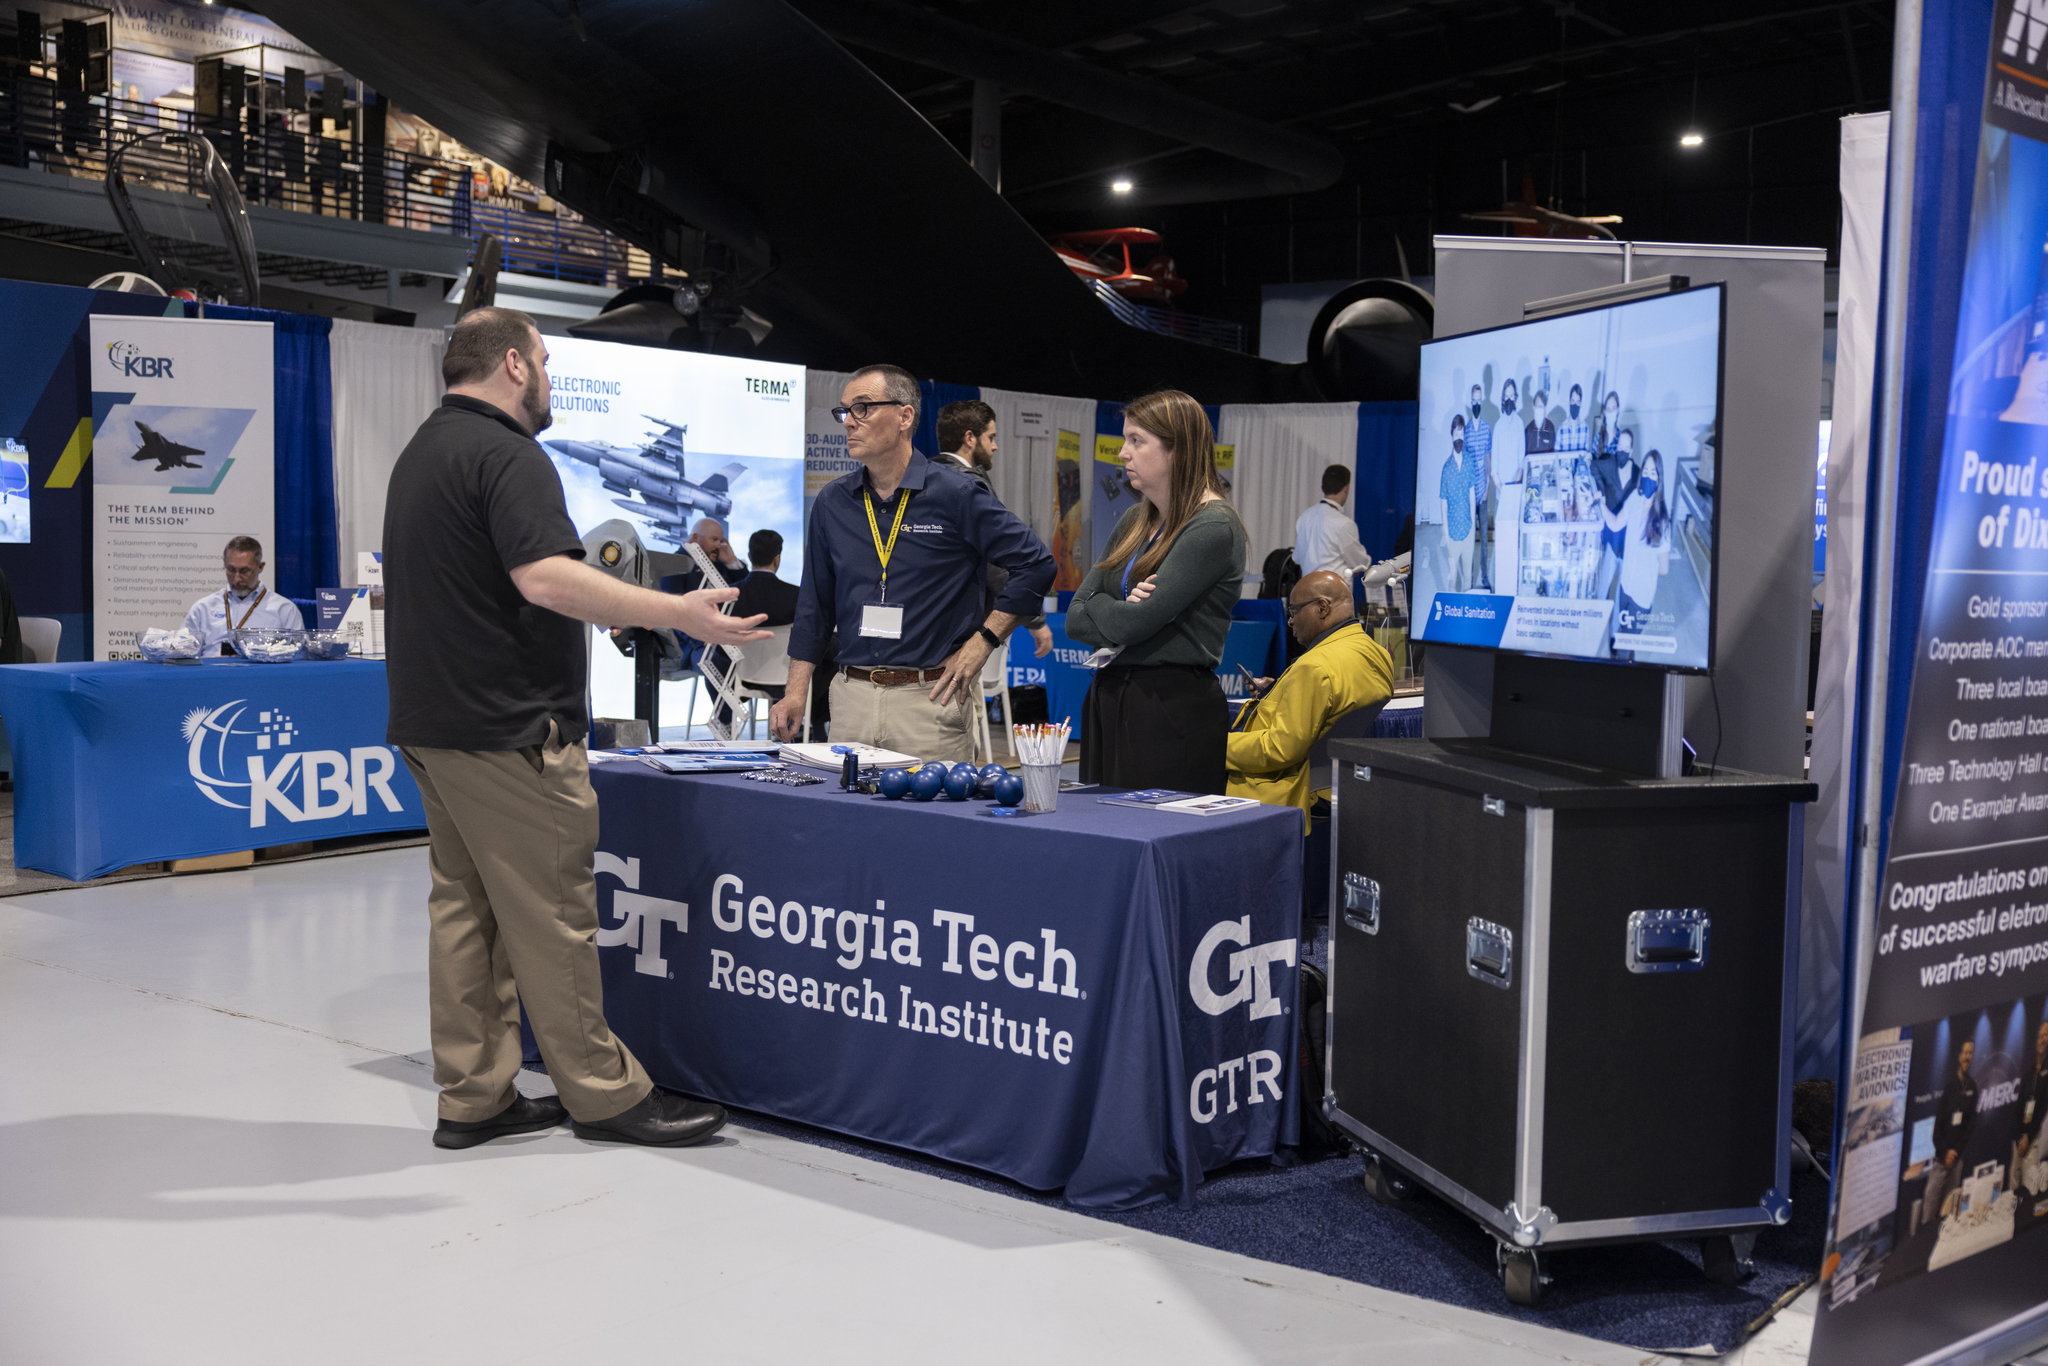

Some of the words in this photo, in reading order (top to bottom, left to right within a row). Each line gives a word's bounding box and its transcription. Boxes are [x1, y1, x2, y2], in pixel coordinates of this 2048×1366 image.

[201, 21, 255, 44] GENERAL
[125, 356, 174, 378] KBR
[551, 375, 621, 396] ELECTRONIC
[745, 377, 790, 397] TERMA
[806, 447, 842, 459] ACTIVE
[1222, 450, 1233, 460] RF
[806, 460, 863, 472] REDUCTION
[1959, 449, 2038, 498] Proud
[108, 505, 130, 514] THE
[134, 505, 167, 514] TEAM
[171, 506, 215, 515] BEHIND
[108, 516, 130, 524] THE
[134, 516, 186, 525] MISSION
[900, 524, 912, 532] GT
[1978, 504, 2011, 548] of
[113, 539, 156, 547] Sustainment
[157, 541, 198, 549] engineering
[141, 598, 182, 606] engineering
[1444, 604, 1463, 618] Global
[1464, 606, 1496, 619] Sanitation
[1517, 604, 1543, 615] Reinvented
[1543, 606, 1556, 615] toilet
[1556, 607, 1570, 616] could
[1583, 609, 1603, 619] millions
[1966, 594, 2001, 618] Gold
[1516, 617, 1521, 625] of
[1522, 618, 1533, 626] lives
[1533, 618, 1539, 626] in
[1539, 619, 1561, 628] locations
[1561, 621, 1580, 629] without
[1619, 609, 1635, 629] GT
[1636, 610, 1660, 623] Georgia
[1660, 612, 1675, 623] Tech
[1516, 629, 1528, 637] basic
[1928, 636, 1993, 665] Corporate
[1993, 636, 2024, 659] AOC
[1956, 677, 1995, 701] Three
[1995, 675, 2025, 699] local
[1948, 718, 1978, 741] One
[1979, 716, 2026, 739] national
[1909, 763, 1945, 786] Three
[1948, 757, 2016, 782] Technology
[2017, 752, 2042, 774] Hall
[246, 745, 405, 829] KBR
[1929, 801, 1960, 824] One
[1961, 794, 2018, 821] Examplar
[1889, 867, 2026, 912] Congratulations
[593, 851, 689, 978] GT
[711, 873, 922, 970] Georgia
[932, 909, 1079, 998] Tech
[1879, 924, 1899, 956] of
[1899, 907, 1997, 950] successful
[1189, 914, 1297, 1022] GT
[1920, 952, 1987, 988] warfare
[709, 948, 887, 1023] Research
[898, 984, 1073, 1065] Institute
[1856, 1060, 1909, 1086] WARFARE
[1859, 1076, 1908, 1101] AVIONICS
